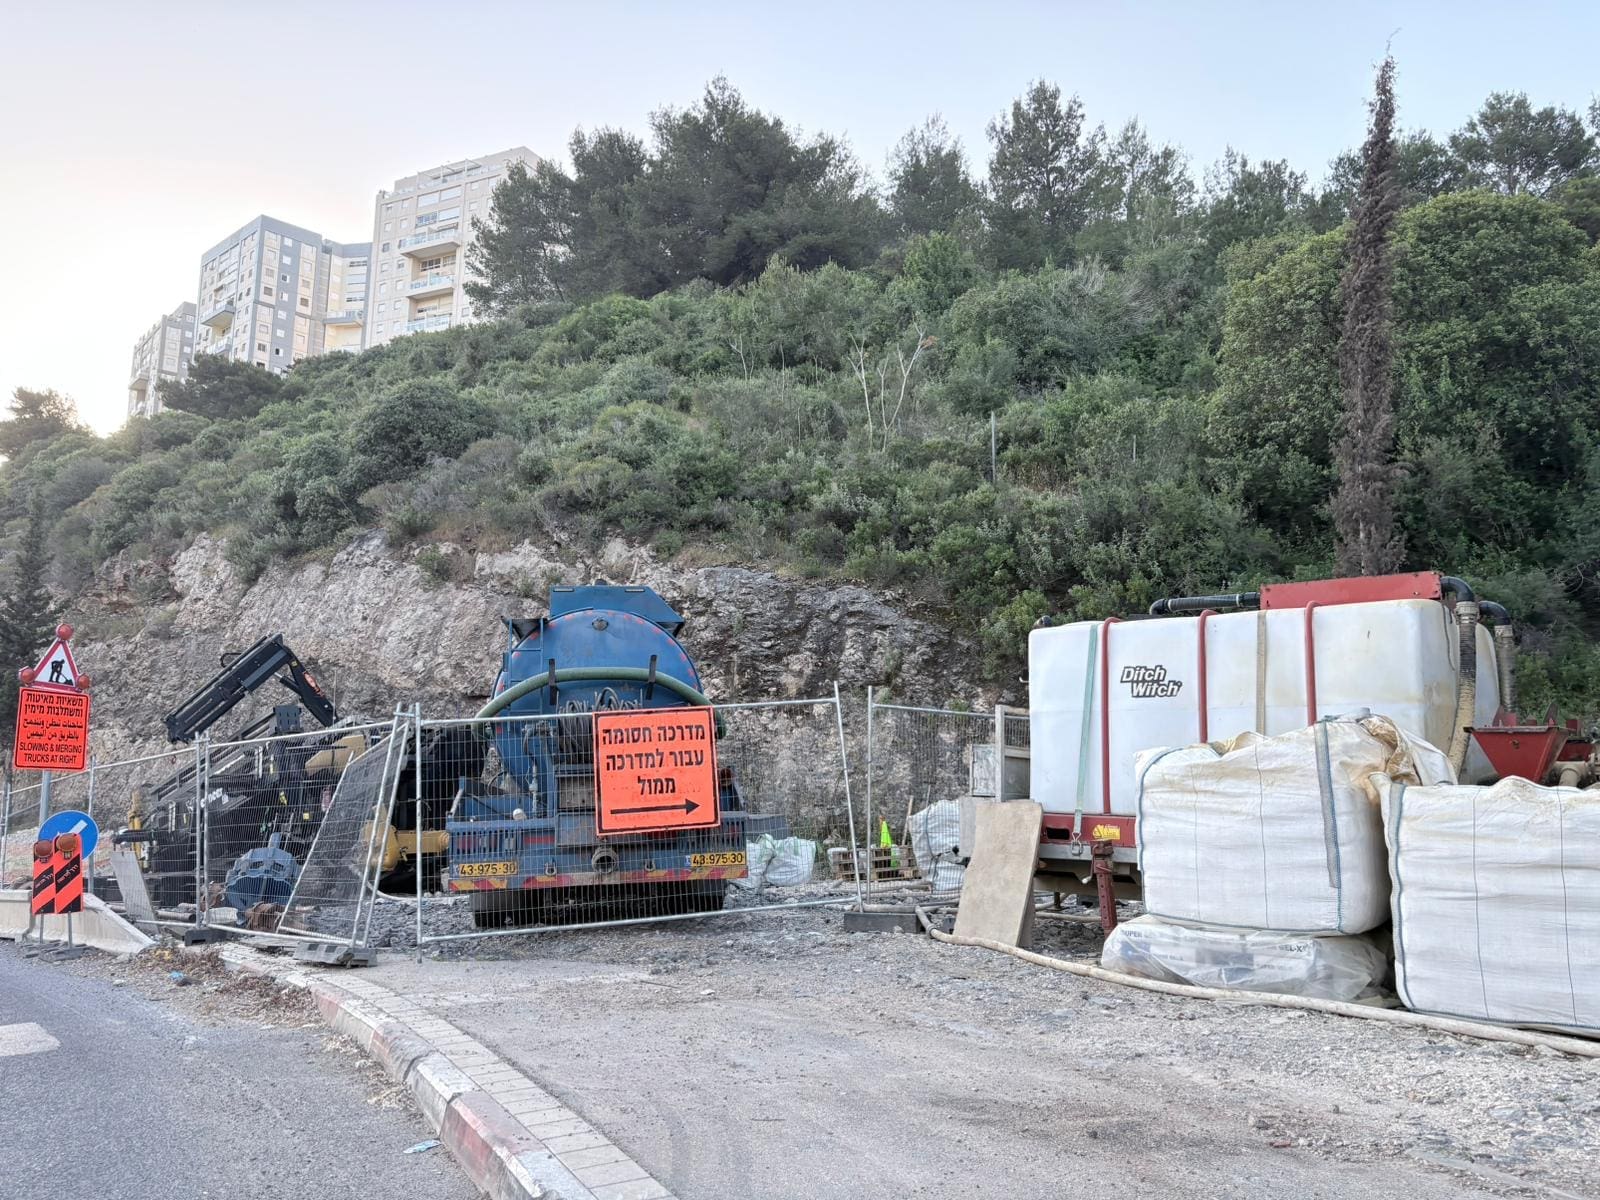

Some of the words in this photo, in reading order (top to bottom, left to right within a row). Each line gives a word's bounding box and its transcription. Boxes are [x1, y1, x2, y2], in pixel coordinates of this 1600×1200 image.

[1120, 664, 1167, 683] Ditch
[26, 693, 55, 704] מאיטות
[56, 695, 83, 707] משאיות
[25, 703, 45, 715] מימין
[602, 726, 652, 745] חסומה
[657, 724, 705, 742] מדרכה
[20, 741, 49, 752] SLOWING
[49, 744, 54, 752] &
[56, 744, 82, 754] MERGING
[24, 753, 50, 763] TRUCKS
[50, 755, 59, 763] AT
[59, 755, 77, 764] RIGHT
[606, 748, 664, 771] למדרכה
[669, 749, 704, 767] עבור
[637, 775, 676, 795] ממול
